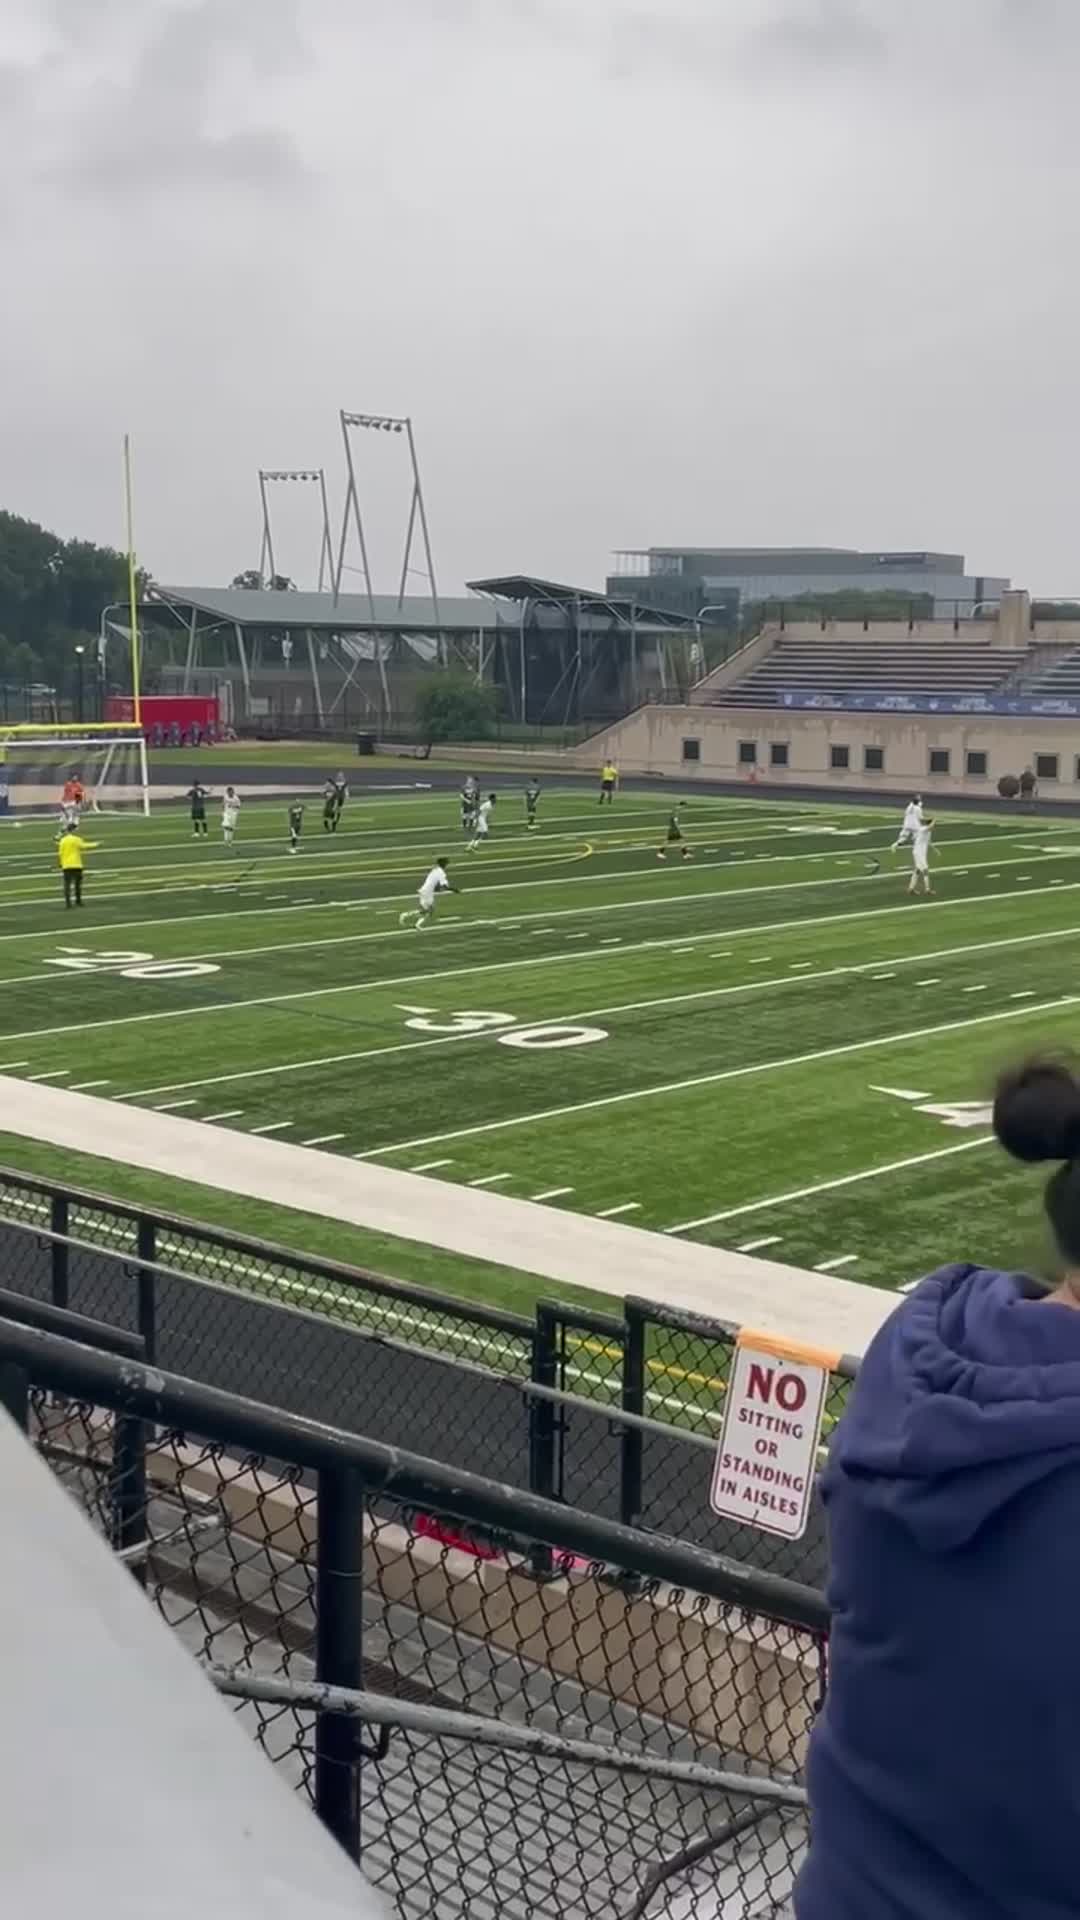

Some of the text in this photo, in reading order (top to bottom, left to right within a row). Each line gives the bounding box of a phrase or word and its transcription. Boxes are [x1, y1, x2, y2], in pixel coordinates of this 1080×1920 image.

[43, 951, 221, 979] 20
[404, 1010, 609, 1048] 30
[747, 1364, 807, 1411] NO
[738, 1408, 803, 1439] SITTING
[755, 1440, 778, 1458] OR
[722, 1454, 803, 1492] STANDING
[720, 1479, 798, 1516] IN AISLES
